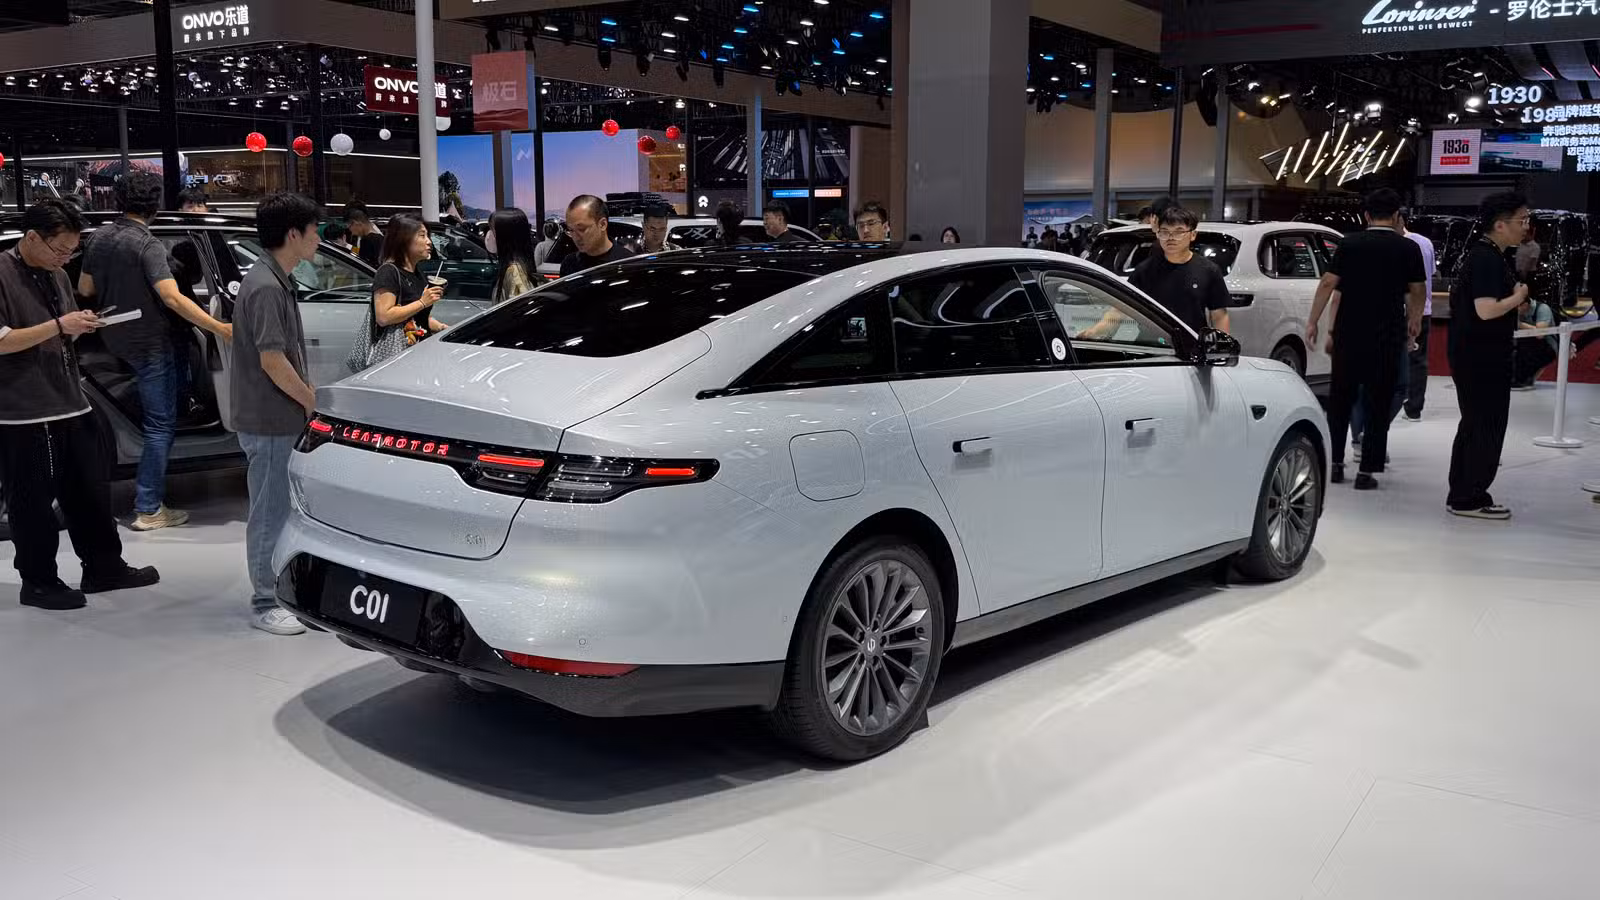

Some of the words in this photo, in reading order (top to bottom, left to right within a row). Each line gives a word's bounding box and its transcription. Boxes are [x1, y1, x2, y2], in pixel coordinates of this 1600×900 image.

[1362, 0, 1477, 25] Lorinser
[1507, 0, 1600, 21] 罗伦士汽
[1437, 20, 1473, 29] BEWEGT
[1488, 85, 1542, 104] 1930
[343, 426, 449, 457] LEAPMOTOR
